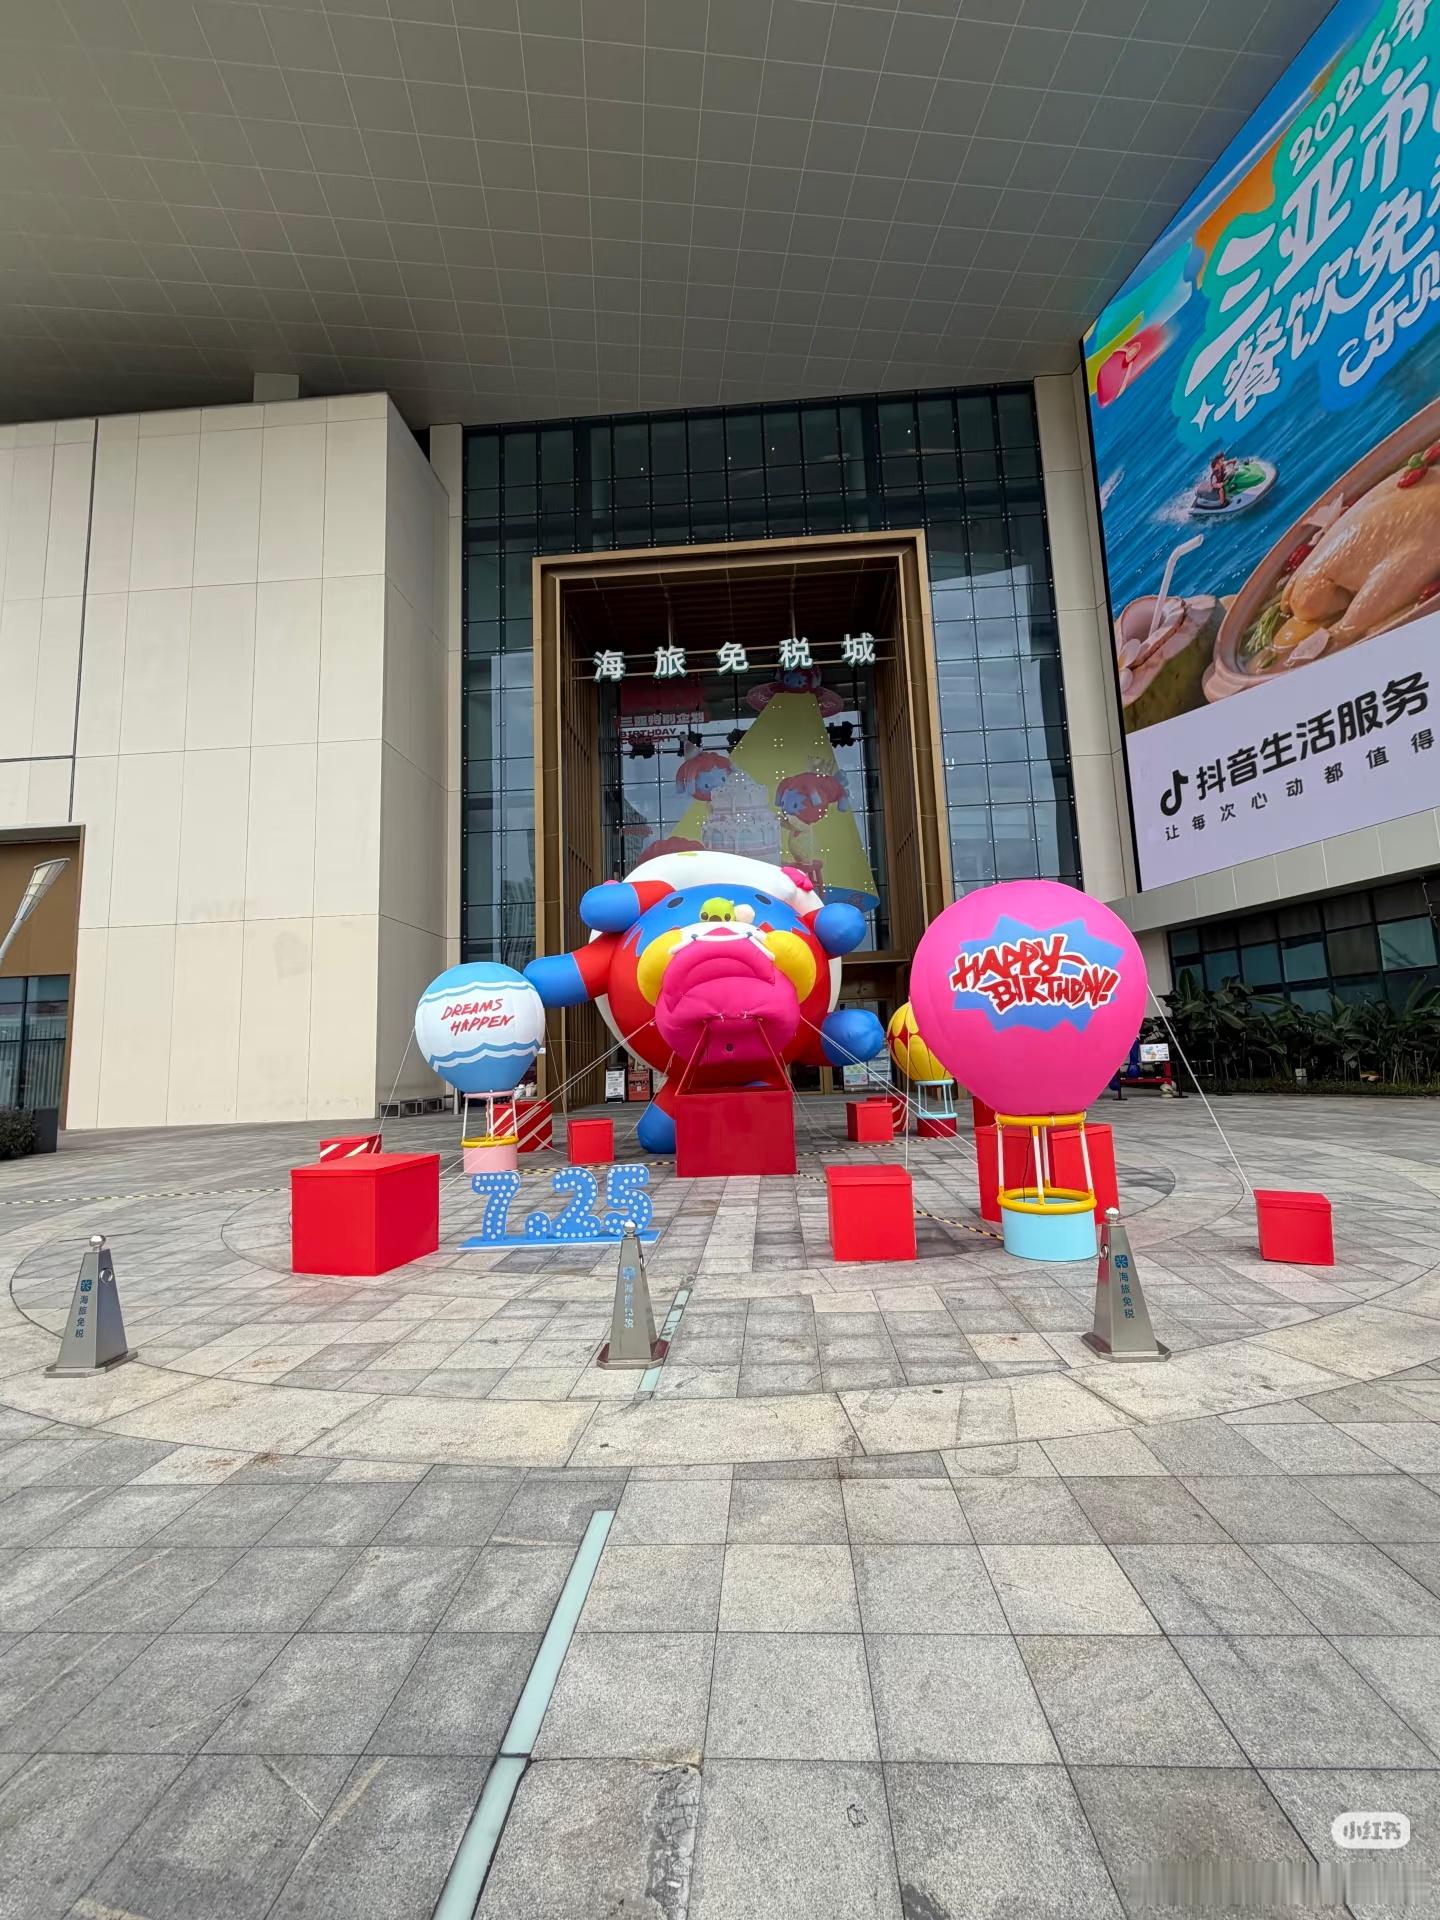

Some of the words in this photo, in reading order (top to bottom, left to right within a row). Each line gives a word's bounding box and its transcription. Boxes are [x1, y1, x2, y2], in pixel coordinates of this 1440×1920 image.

[1185, 56, 1440, 397] 三亚市
[593, 632, 876, 682] 海旅免税城
[1196, 671, 1430, 801] 抖音生活服务
[1165, 728, 1435, 841] 让每次心动都值得
[950, 935, 1088, 991] HAPPY
[441, 998, 503, 1021] DREAMS
[980, 964, 1120, 1014] BIRTHDAY!
[450, 1014, 515, 1036] HAPPEN
[471, 1164, 653, 1241] 7.25
[75, 1295, 89, 1338] 海旅免税
[1119, 1272, 1135, 1319] 海旅免税
